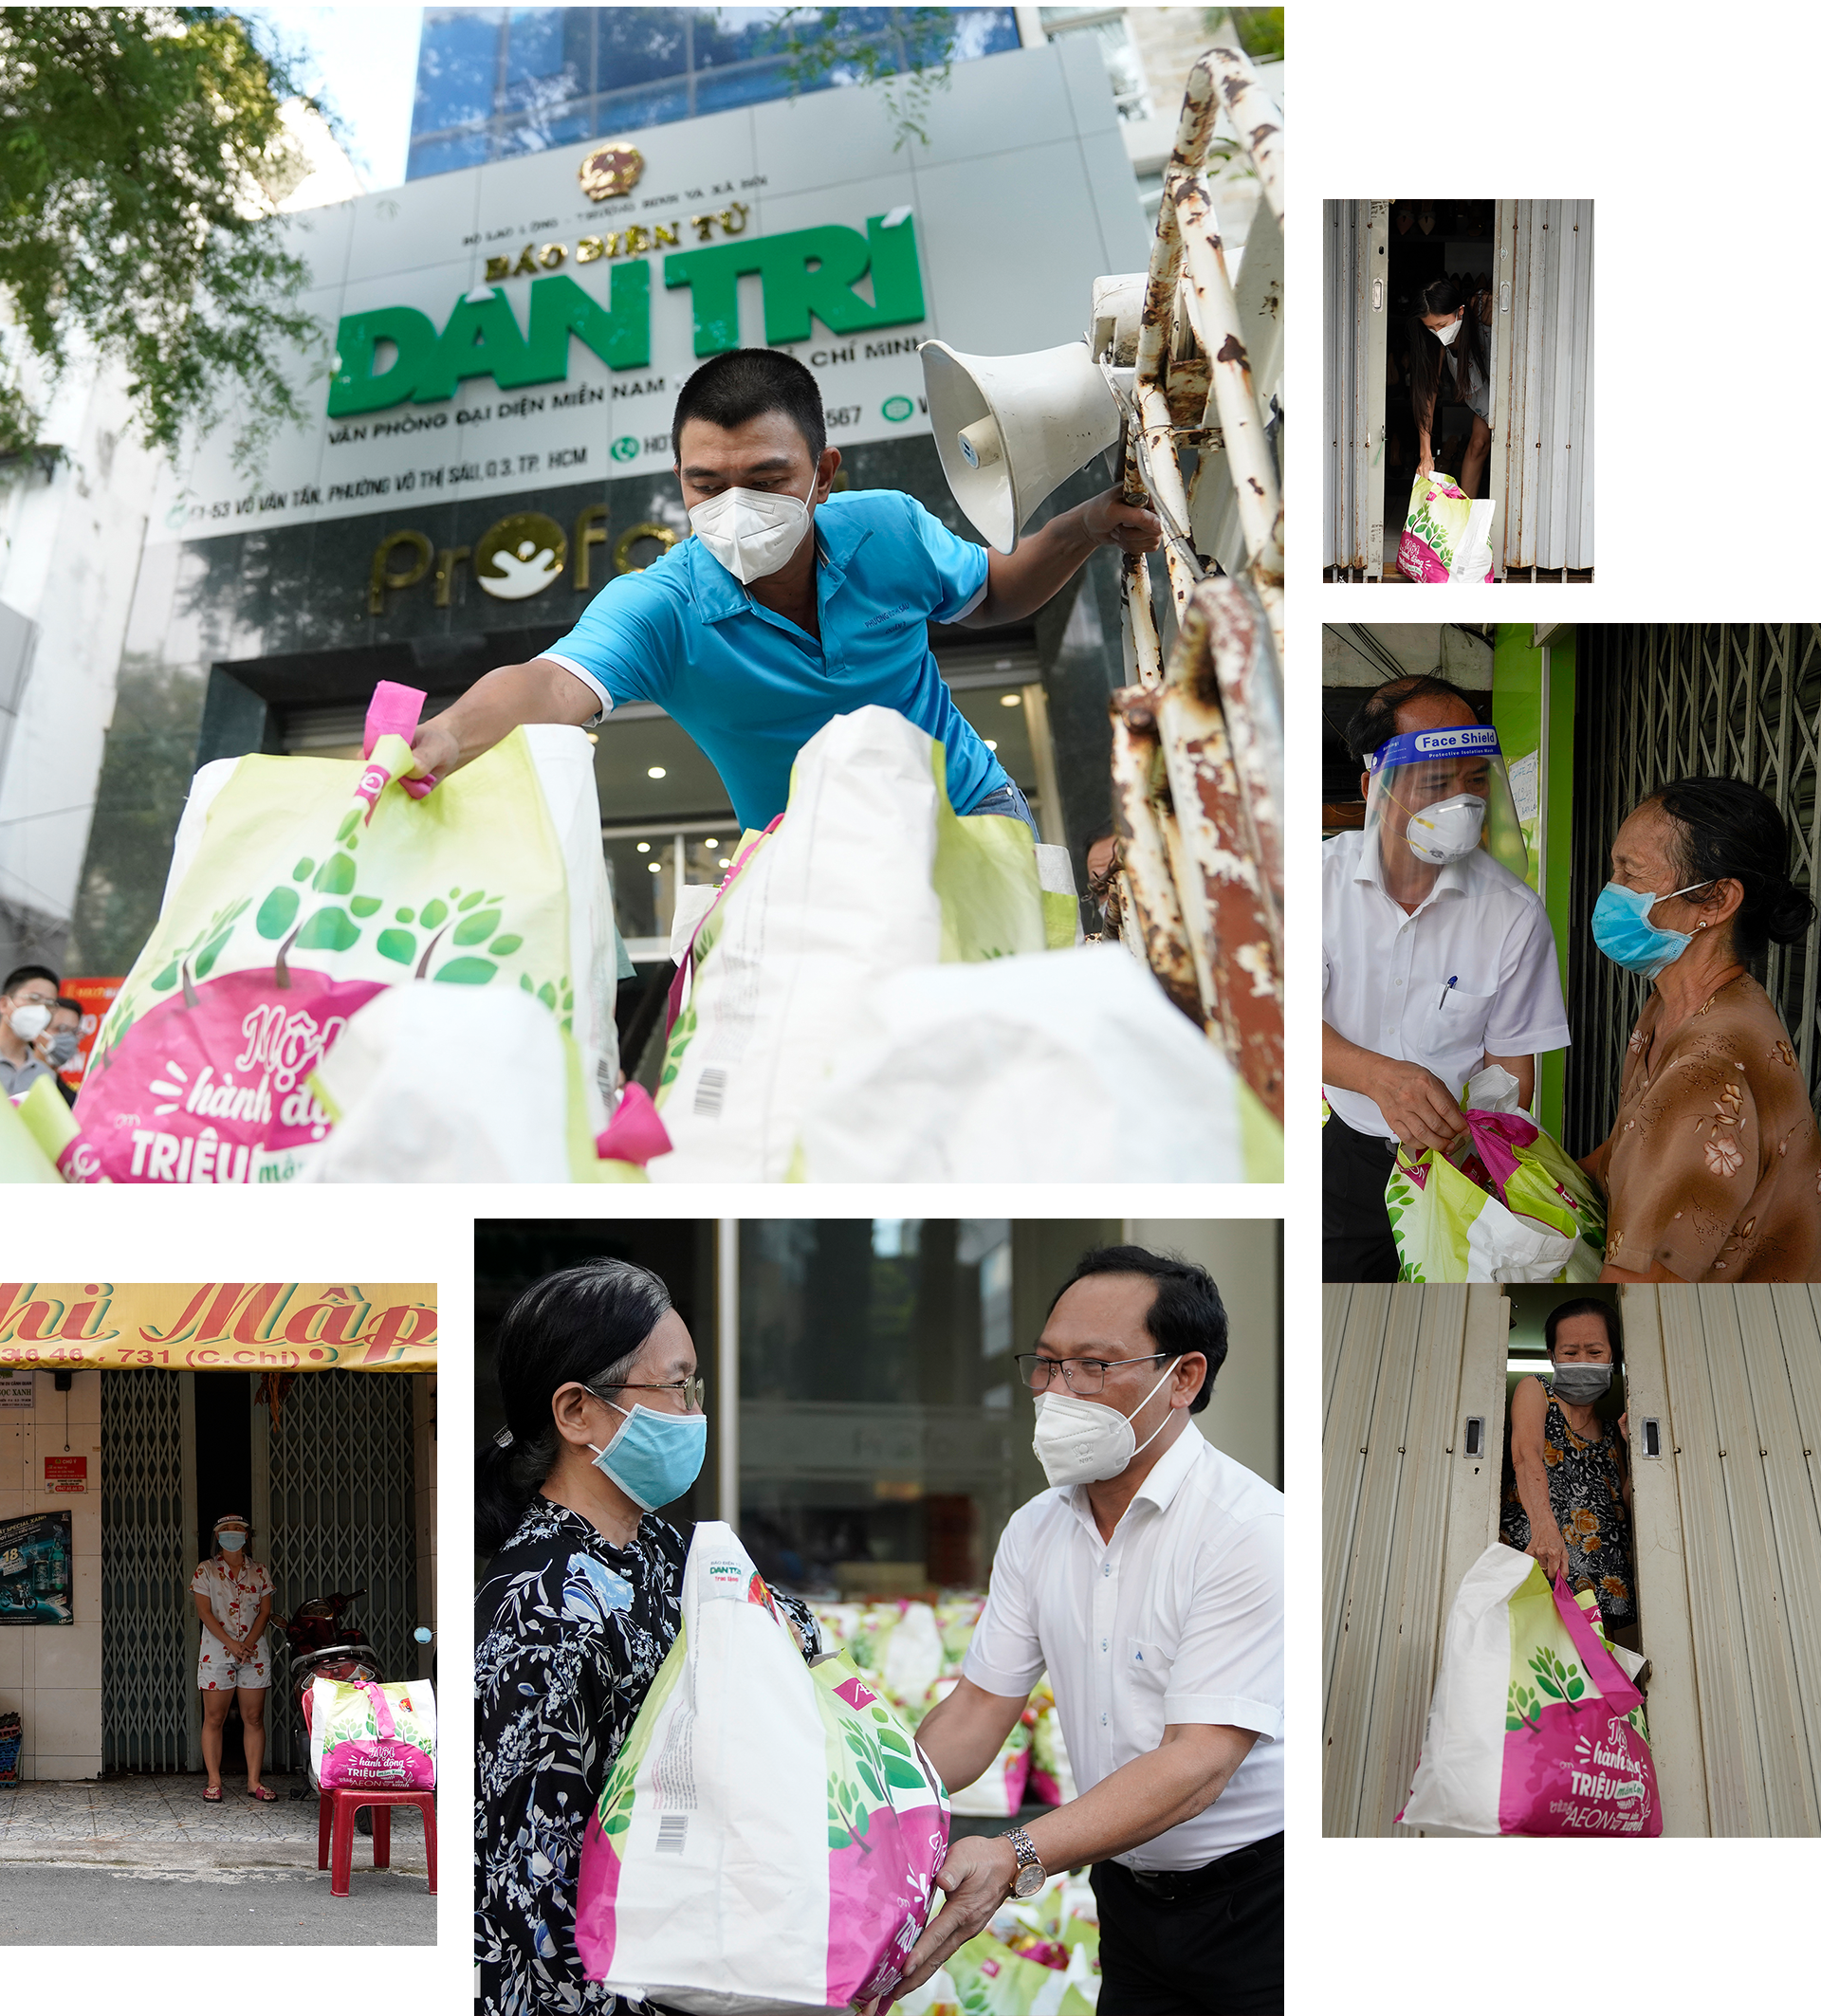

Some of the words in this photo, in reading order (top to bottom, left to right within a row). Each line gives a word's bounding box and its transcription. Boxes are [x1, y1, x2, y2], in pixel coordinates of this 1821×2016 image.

[484, 242, 569, 282] BÁO
[326, 259, 651, 418] DÂN
[664, 204, 926, 359] TRÍ
[811, 340, 855, 367] CHÍ
[373, 412, 448, 438] PHÒNG
[455, 408, 491, 428] ĐẠI
[498, 396, 544, 421] DIỆN
[552, 383, 604, 410] MIỀN
[612, 376, 667, 398] NAM
[548, 446, 587, 469] HCM
[1423, 737, 1457, 748] Face
[1461, 731, 1495, 744] Shield
[1428, 750, 1461, 759] Protective
[1461, 747, 1483, 756] Isolation
[186, 1066, 273, 1125] hành
[0, 1282, 120, 1344] hi
[139, 1282, 438, 1365] Mập
[49, 1347, 84, 1362] 46
[118, 1348, 170, 1364] 731
[185, 1349, 301, 1368] (C.Chi)
[7, 1520, 29, 1531] SPECIAL
[2, 1548, 19, 1563] 18
[359, 1756, 381, 1768] hành
[383, 1758, 406, 1770] động
[1593, 1740, 1627, 1770] hành
[347, 1768, 376, 1779] TRIỆU
[350, 1779, 381, 1787] AEON
[1572, 1770, 1616, 1805] TRIỆU
[1561, 1806, 1614, 1829] AEON
